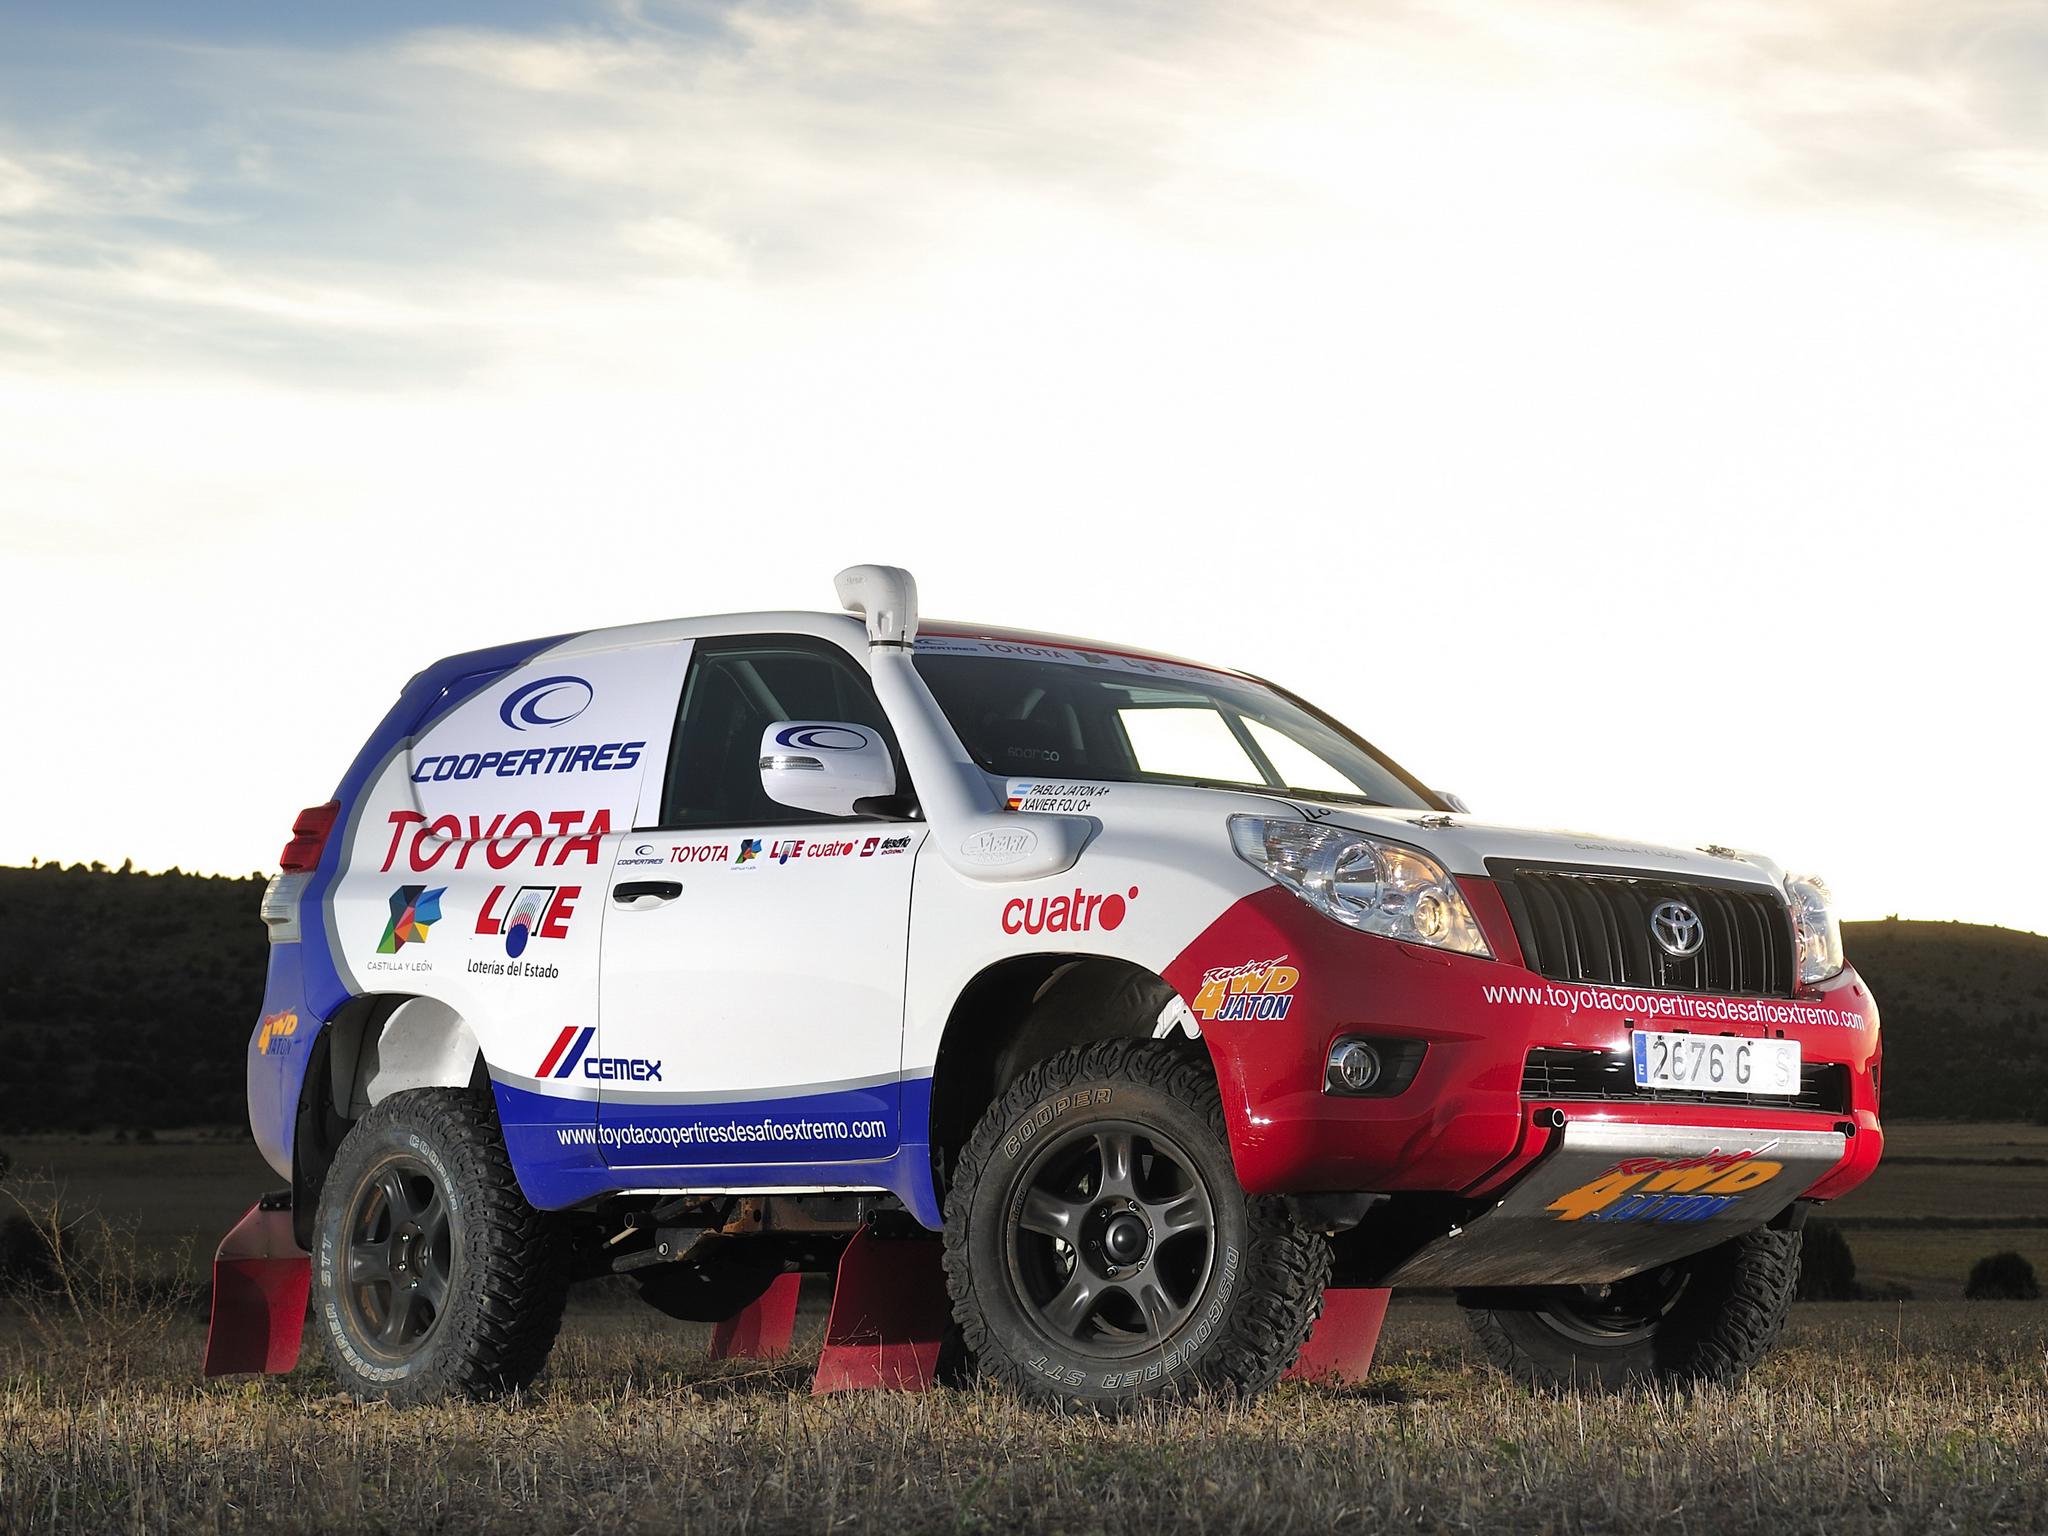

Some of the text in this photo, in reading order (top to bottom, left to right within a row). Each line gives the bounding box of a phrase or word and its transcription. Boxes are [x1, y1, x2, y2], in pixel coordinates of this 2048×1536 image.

[978, 643, 1069, 660] TOYOTA
[411, 741, 646, 783] COOPERTIRES
[1022, 798, 1057, 811] XAVIER
[1057, 799, 1078, 812] FOJ
[1030, 784, 1063, 796] PABLO
[1063, 786, 1096, 797] JATON
[379, 808, 611, 873] TOYOTA
[670, 845, 728, 863] TOYOTA
[807, 839, 859, 858] cuatro
[617, 858, 664, 866] COOPERTIRES
[1001, 886, 1139, 935] cuatro
[367, 960, 433, 972] CASTILLA Y LEÓN
[467, 958, 559, 979] Loterías del Estado
[1202, 954, 1288, 987] Racing
[1191, 966, 1300, 1020] 4WD
[1217, 994, 1294, 1021] JATON
[1481, 983, 1865, 1031] www.toyotacoopertiresdesafioextremo.com
[584, 1058, 662, 1081] CEMEX
[1638, 1063, 1645, 1075] E
[1652, 1041, 1724, 1083] 2676
[557, 1118, 887, 1149] www.toyotacoopertiresdesafioextremo.com
[1004, 1087, 1113, 1160] COOPER
[409, 1134, 459, 1212] COOPER
[321, 1233, 334, 1288] STT
[1101, 1246, 1240, 1389] DISCOVERER
[324, 1303, 411, 1382] DISCOVERER
[1028, 1356, 1087, 1387] STT
